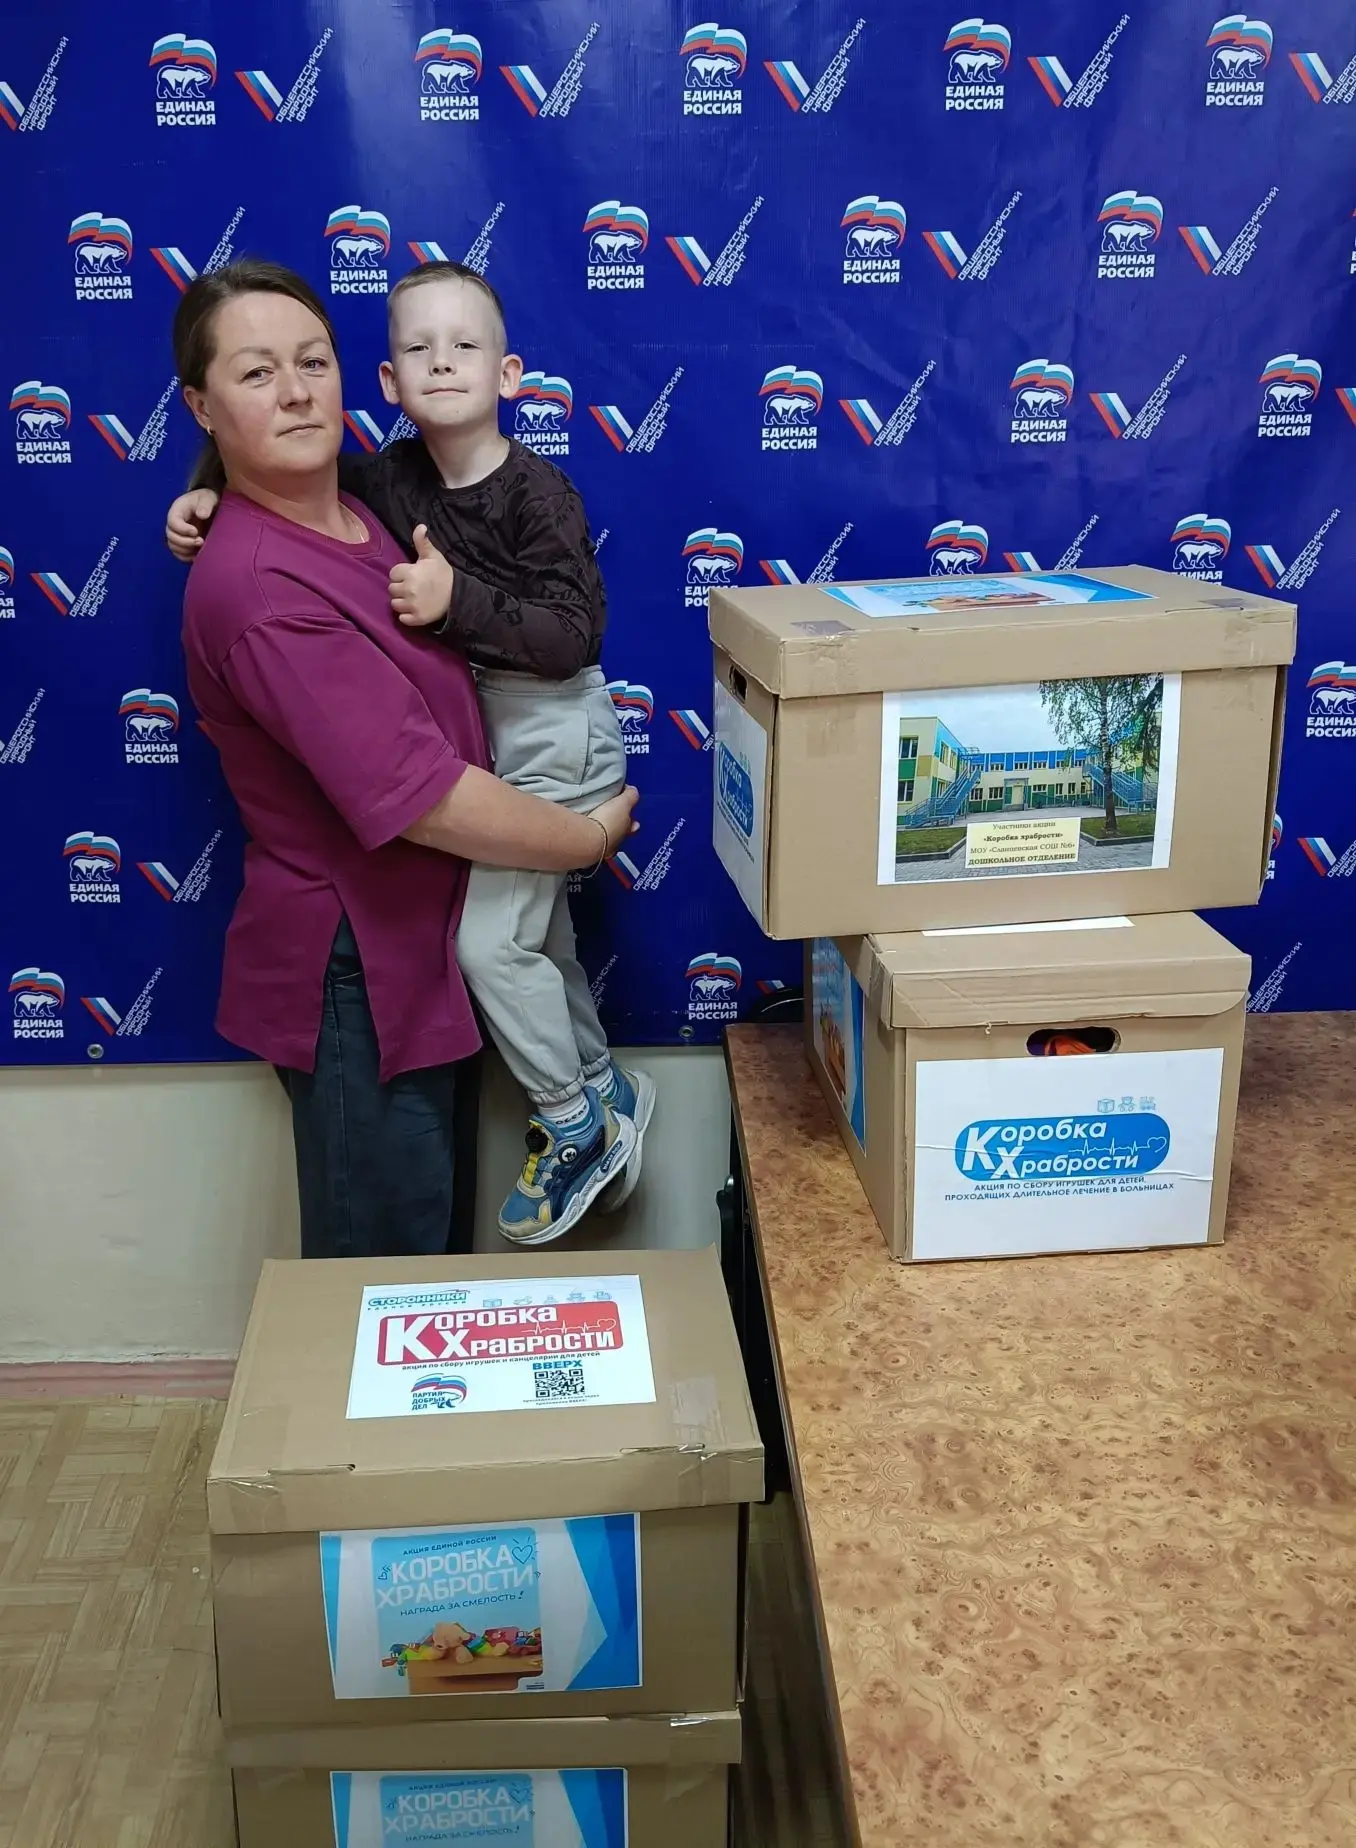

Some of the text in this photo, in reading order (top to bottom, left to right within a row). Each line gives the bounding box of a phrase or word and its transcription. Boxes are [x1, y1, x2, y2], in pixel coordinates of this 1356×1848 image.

[275, 27, 333, 123] ОБЩЕРОССИЙСКИЙ
[539, 22, 600, 118] ОБЩЕРОССИЙСКИЙ
[801, 18, 866, 113] ОБЩЕРОССИЙСКИЙ
[1063, 14, 1130, 109] ОБЩЕРОССИЙСКИЙ
[18, 36, 69, 132] ОБЩЕРОССИЙСКИЙ
[286, 66, 321, 122] НАРОДНЫЙ
[549, 61, 586, 118] НАРОДНЫЙ
[811, 57, 851, 113] НАРОДНЫЙ
[821, 76, 847, 113] ФРОНТ
[946, 86, 1004, 97] ЕДИНАЯ
[1073, 52, 1114, 108] НАРОДНЫЙ
[1083, 71, 1109, 108] ФРОНТ
[1207, 82, 1264, 93] ЕДИНАЯ
[27, 75, 59, 131] НАРОДНЫЙ
[156, 101, 214, 113] ЕДИНАЯ
[295, 85, 319, 122] ФРОНТ
[420, 96, 478, 108] ЕДИНАЯ
[559, 80, 583, 118] ФРОНТ
[684, 90, 741, 102] ЕДИНАЯ
[684, 103, 741, 115] РОССИЯ
[946, 98, 1003, 110] РОССИЯ
[1206, 95, 1263, 105] РОССИЯ
[36, 94, 57, 131] ФРОНТ
[157, 114, 216, 126] РОССИЯ
[421, 109, 479, 120] РОССИЯ
[203, 206, 246, 275] ЕРОССИЙСКИЙ
[702, 195, 765, 287] ОБЩЕРОССИЙСКИЙ
[958, 191, 1023, 281] ОБЩЕРОССИЙСКИЙ
[1212, 186, 1279, 276] ОБЩЕРОССИЙСКИЙ
[712, 233, 750, 287] НАРОДНЫЙ
[968, 227, 1007, 281] НАРОДНЫЙ
[977, 246, 1003, 281] ФРОНТ
[1099, 255, 1155, 266] ЕДИНАЯ
[1222, 223, 1262, 276] НАРОДНЫЙ
[1231, 241, 1258, 276] ФРОНТ
[330, 270, 387, 281] ЕДИНАЯ
[588, 265, 644, 277] ЕДИНАЯ
[722, 251, 746, 287] ФРОНТ
[844, 260, 900, 271] ЕДИНАЯ
[844, 272, 899, 283] РОССИЯ
[1098, 267, 1154, 278] РОССИЯ
[75, 276, 131, 288] ЕДИНАЯ
[76, 288, 132, 300] РОССИЯ
[331, 282, 388, 294] РОССИЯ
[588, 278, 644, 289] РОССИЯ
[625, 366, 685, 453] ОБЩЕРОССИЙСКИЙ
[873, 360, 937, 447] ОБЩЕРОССИЙСКИЙ
[1122, 354, 1187, 440] ОБЩЕРОССИЙСКИЙ
[127, 375, 181, 462] ОБЩЕРОССИЙСКИЙ
[635, 402, 671, 453] НАРОДНЫЙ
[883, 395, 922, 446] НАРОДНЫЙ
[892, 412, 917, 446] ФРОНТ
[1012, 420, 1066, 431] ЕДИНАЯ
[1131, 389, 1171, 440] НАРОДНЫЙ
[1141, 406, 1166, 440] ФРОНТ
[1259, 414, 1312, 425] ЕДИНАЯ
[137, 411, 169, 461] НАРОДНЫЙ
[146, 428, 168, 461] ФРОНТ
[644, 419, 668, 453] ФРОНТ
[762, 427, 817, 438] ЕДИНАЯ
[762, 439, 816, 450] РОССИЯ
[1011, 432, 1066, 442] РОССИЯ
[1258, 426, 1310, 437] РОССИЯ
[16, 441, 70, 452] ЕДИНАЯ
[17, 453, 71, 463] РОССИЯ
[524, 445, 570, 455] ССИЯ
[1275, 508, 1341, 590] ОБЩЕРОССИЙСКИЙ
[69, 536, 120, 618] ОБЩЕРОССИЙСКИЙ
[1285, 542, 1324, 589] НАРОДНЫЙ
[1294, 558, 1320, 590] ФРОНТ
[78, 569, 110, 617] НАРОДНЫЙ
[87, 586, 109, 617] ФРОНТ
[125, 744, 177, 753] ЕДИНАЯ
[126, 754, 178, 763] РОССИЯ
[968, 853, 1076, 865] ДОШКОЛЬНОЕ ОТДЕЛЕНИЕ
[70, 884, 119, 892] ЕДИНАЯ
[71, 894, 120, 903] РОССИЯ
[689, 1002, 737, 1010] ЕДИНАЯ
[689, 1011, 737, 1020] РОССИЯ
[14, 1019, 62, 1028] ЕДИНАЯ
[14, 1030, 64, 1038] РОССИЯ
[962, 1118, 1106, 1170] Коробка
[990, 1146, 1138, 1179] Храбрости
[945, 1192, 1010, 1200] ПРОХОДЯЩИХ
[1012, 1189, 1070, 1198] ДЛИТЕЛЬНОЕ
[1072, 1186, 1110, 1195] ЛЕЧЕНИЕ
[1120, 1183, 1174, 1192] БОЛЬНИЦАХ
[974, 1183, 1004, 1191] АКЦИЯ
[1056, 1179, 1095, 1187] ИГРУШЕК
[368, 1291, 467, 1307] СТОРОННИКИ
[440, 1360, 464, 1368] сбору
[466, 1358, 500, 1367] игрушек
[509, 1354, 558, 1363] канцелярии
[532, 1360, 583, 1370] ВВЕРХ
[412, 1396, 446, 1405] ДОБРЫХ
[412, 1403, 428, 1411] ДЕЛ
[403, 1535, 497, 1555] АКЦИЯ ЕДИНОЙ РОССИИ
[391, 1543, 514, 1584] КОРОБКА
[376, 1565, 533, 1609] ХРАБРОСТИ
[400, 1603, 446, 1617] НАГРАДА
[448, 1601, 461, 1610] ЗА
[398, 1786, 511, 1814] КОРОБКА
[384, 1804, 530, 1834] ХРАБРОСТИ
